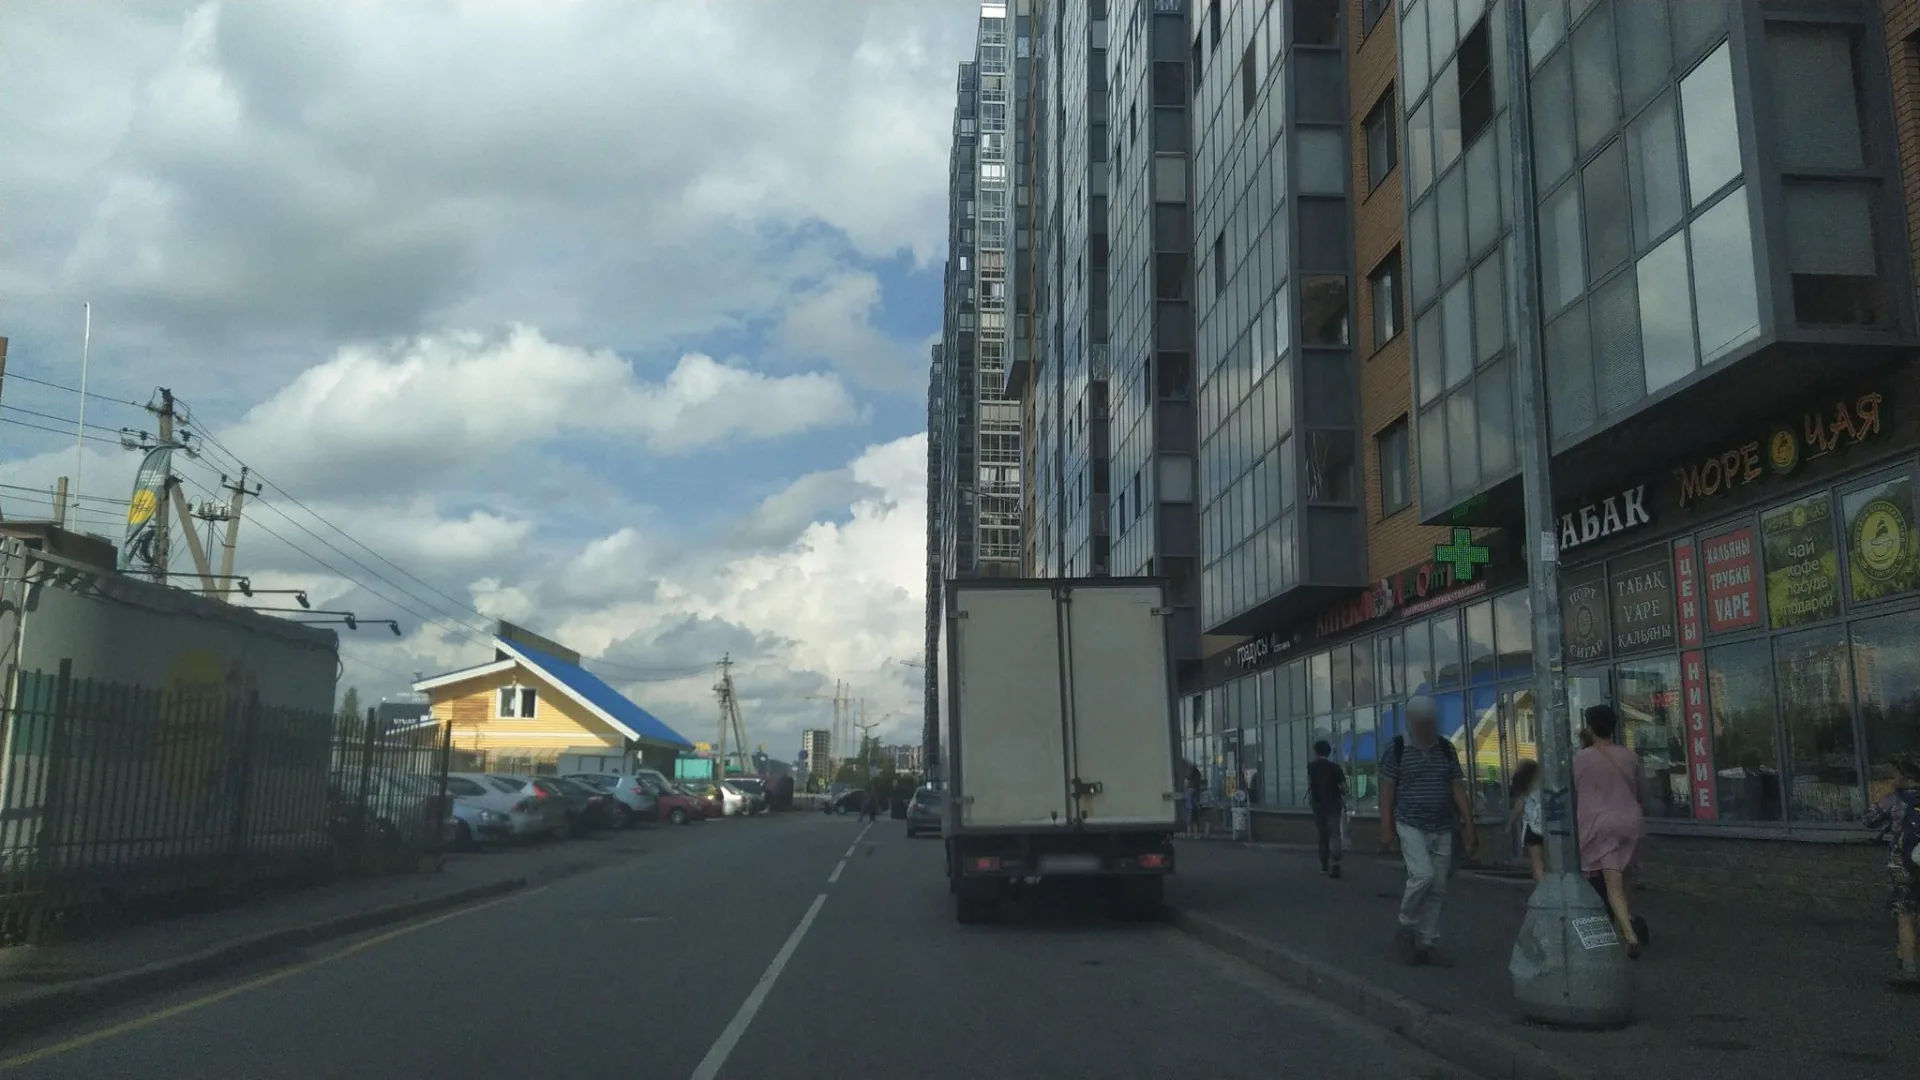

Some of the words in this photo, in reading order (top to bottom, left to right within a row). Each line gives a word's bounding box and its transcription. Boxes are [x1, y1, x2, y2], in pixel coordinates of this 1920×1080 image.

[1676, 441, 1762, 508] МОРЕ
[1804, 392, 1882, 452] ЧАЯ
[1707, 537, 1750, 564] КАЛЬЯНЫ
[1787, 536, 1816, 559] чай
[1710, 565, 1751, 591] ТРУБКИ
[1787, 558, 1821, 577] кофе
[1569, 586, 1597, 605] ПОРТ
[1617, 570, 1668, 597] ТАБАК
[1786, 576, 1829, 597] посуда
[1622, 599, 1663, 623] VAPE
[1679, 558, 1696, 641] ЦЕНЫ
[1714, 592, 1752, 622] VAPE
[1781, 595, 1834, 616] подарки
[1617, 624, 1671, 648] КАЛЬЯНЫ
[1570, 639, 1603, 659] СИГАР
[1687, 662, 1711, 808] НИЗКИЕ
